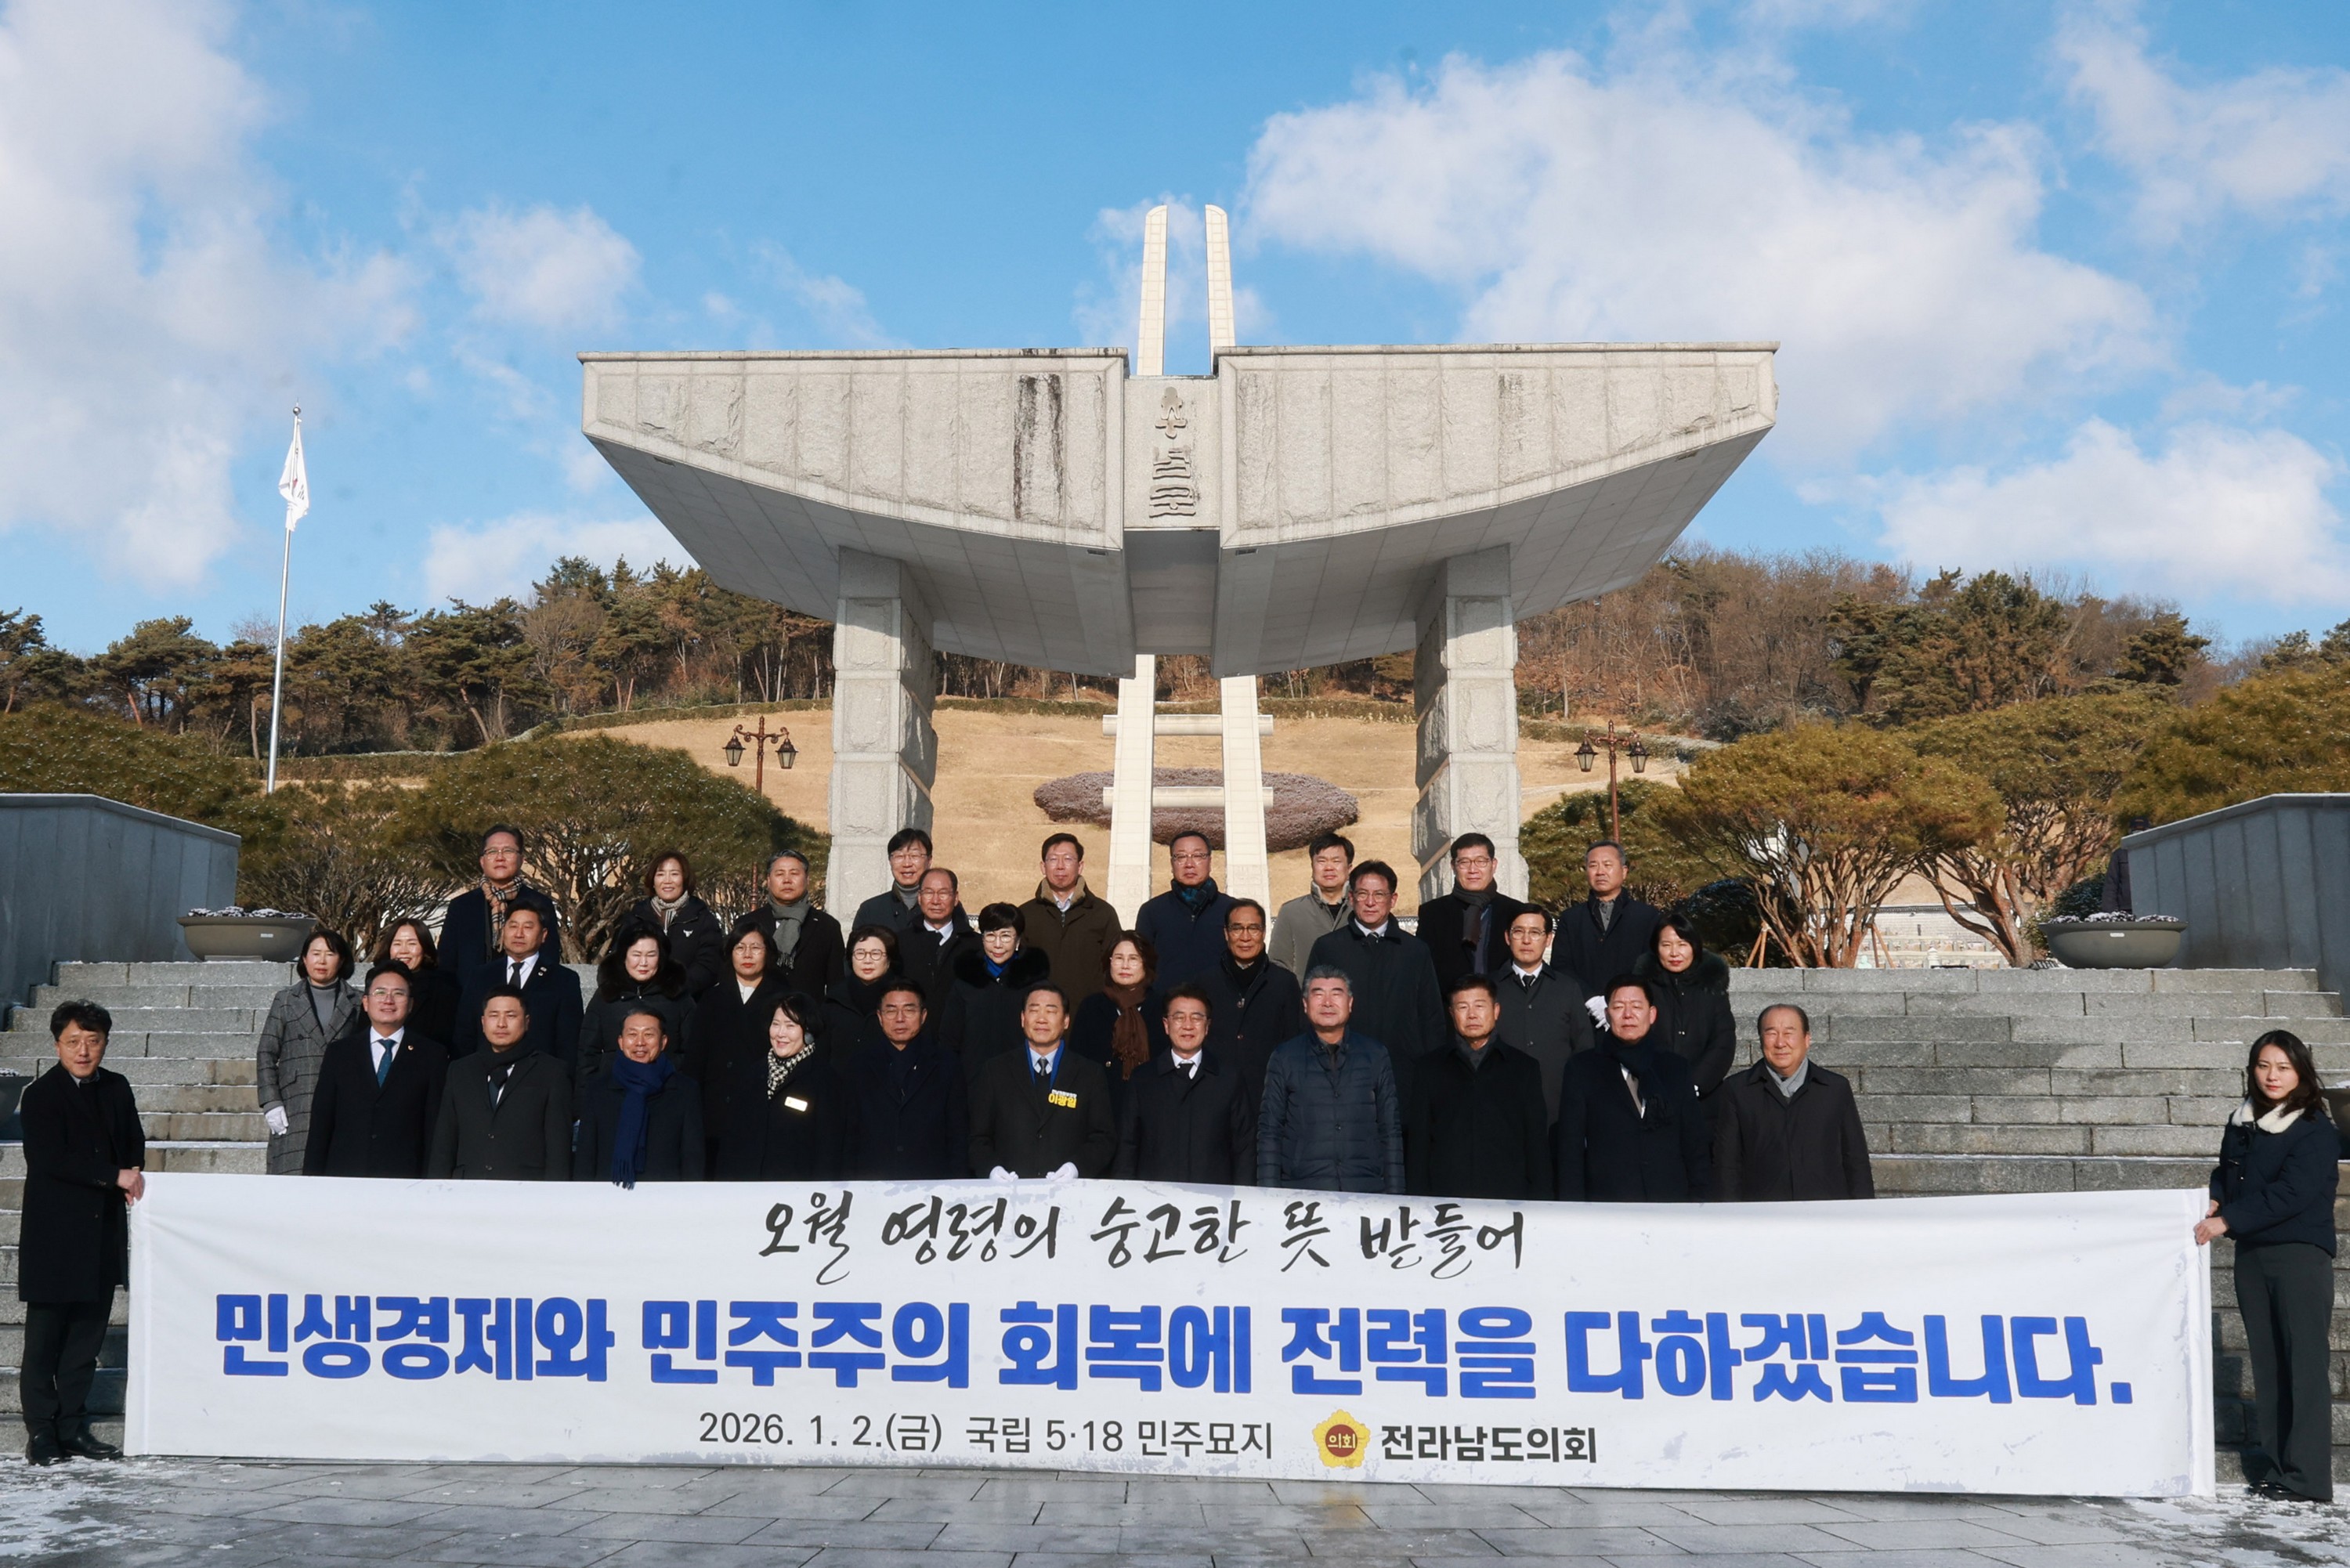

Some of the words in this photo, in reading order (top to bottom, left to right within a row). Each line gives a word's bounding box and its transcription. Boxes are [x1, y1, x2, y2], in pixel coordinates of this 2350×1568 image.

[759, 1191, 853, 1285] 오월
[881, 1195, 1061, 1265] 영령의
[1090, 1195, 1250, 1270] 숭고한
[1281, 1201, 1331, 1272] 뜻
[1360, 1205, 1524, 1278] 받들어
[216, 1294, 615, 1382] 민생경제와
[642, 1300, 970, 1389] 민주주의
[999, 1301, 1251, 1393] 회복에
[1282, 1307, 1536, 1399] 전력을
[1565, 1310, 2132, 1405] 다하겠습니다.
[699, 1412, 793, 1445] 2026.
[810, 1415, 837, 1446] 1.
[966, 1416, 1031, 1454] 국립
[1046, 1420, 1123, 1452] 5·18
[1138, 1420, 1272, 1459] 민주묘지
[1328, 1433, 1356, 1449] 의회
[1382, 1425, 1596, 1463] 전라남도의회
